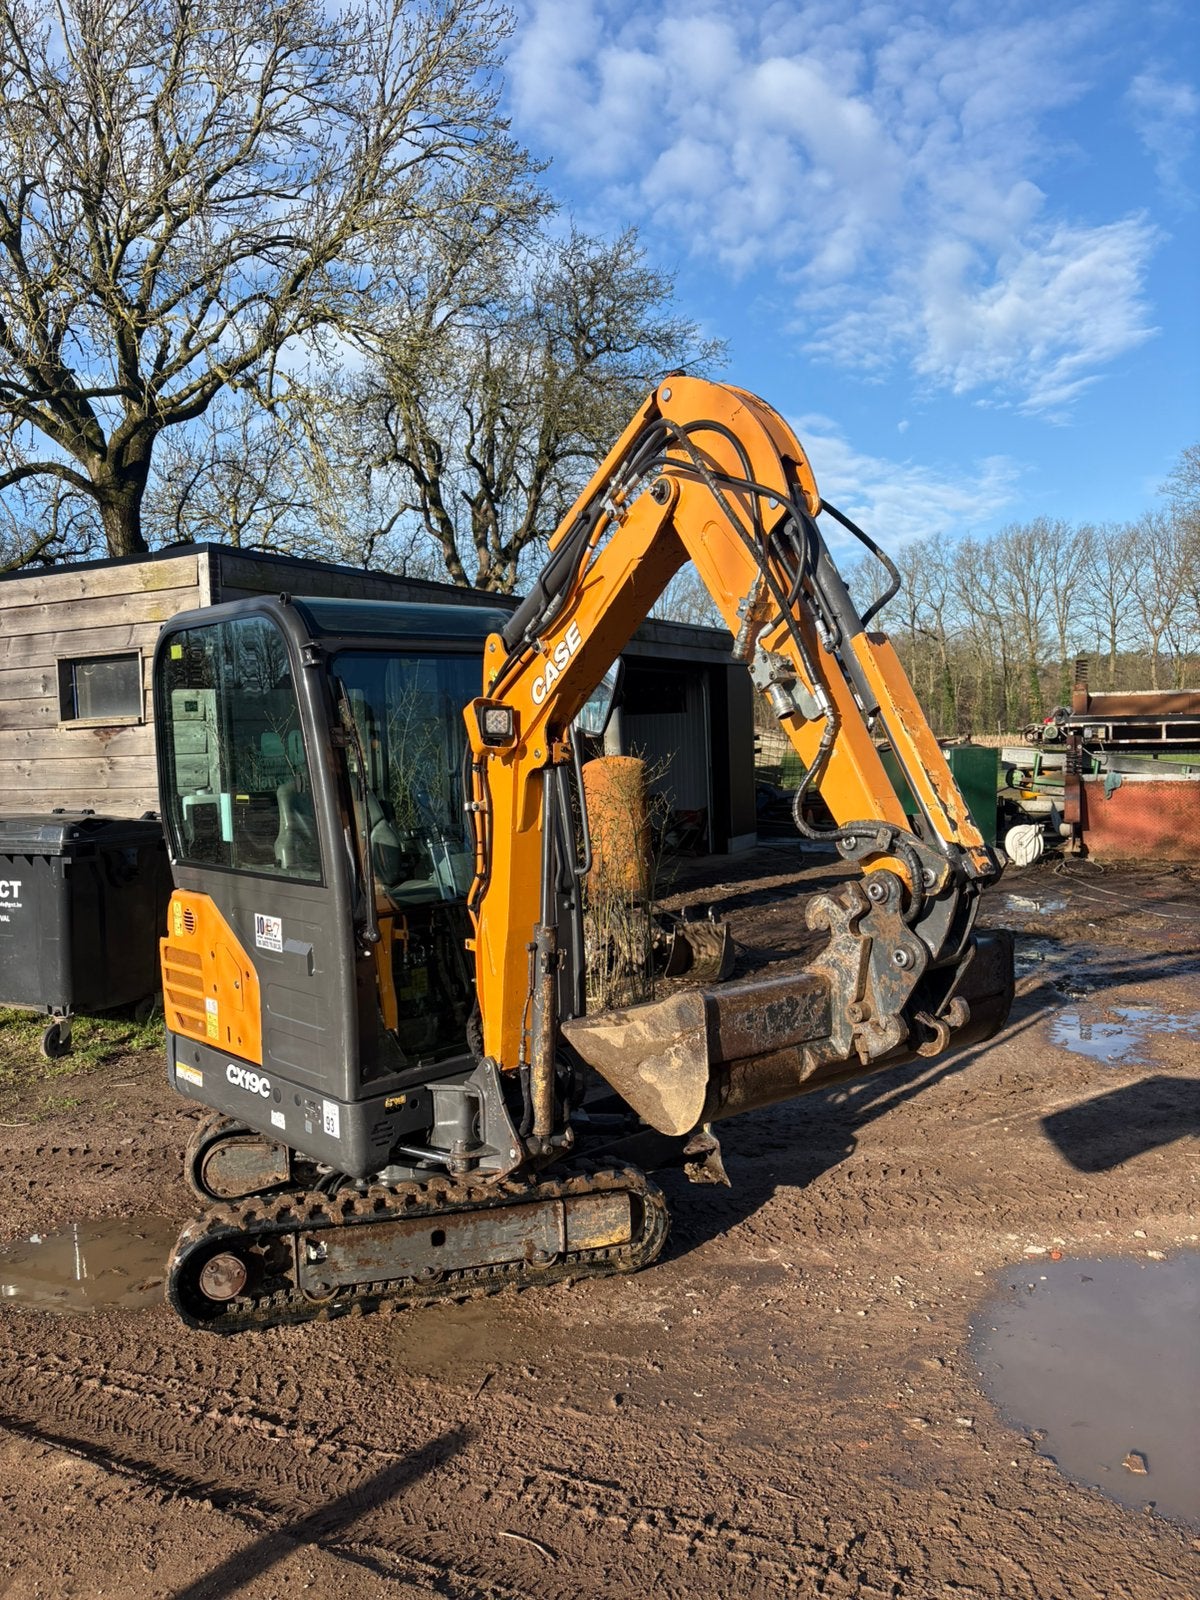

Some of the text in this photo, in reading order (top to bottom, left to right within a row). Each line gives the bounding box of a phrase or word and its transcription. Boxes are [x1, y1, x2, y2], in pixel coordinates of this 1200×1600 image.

[531, 620, 582, 704] CASE
[226, 1063, 271, 1098] CX19C
[325, 1115, 335, 1133] 93
